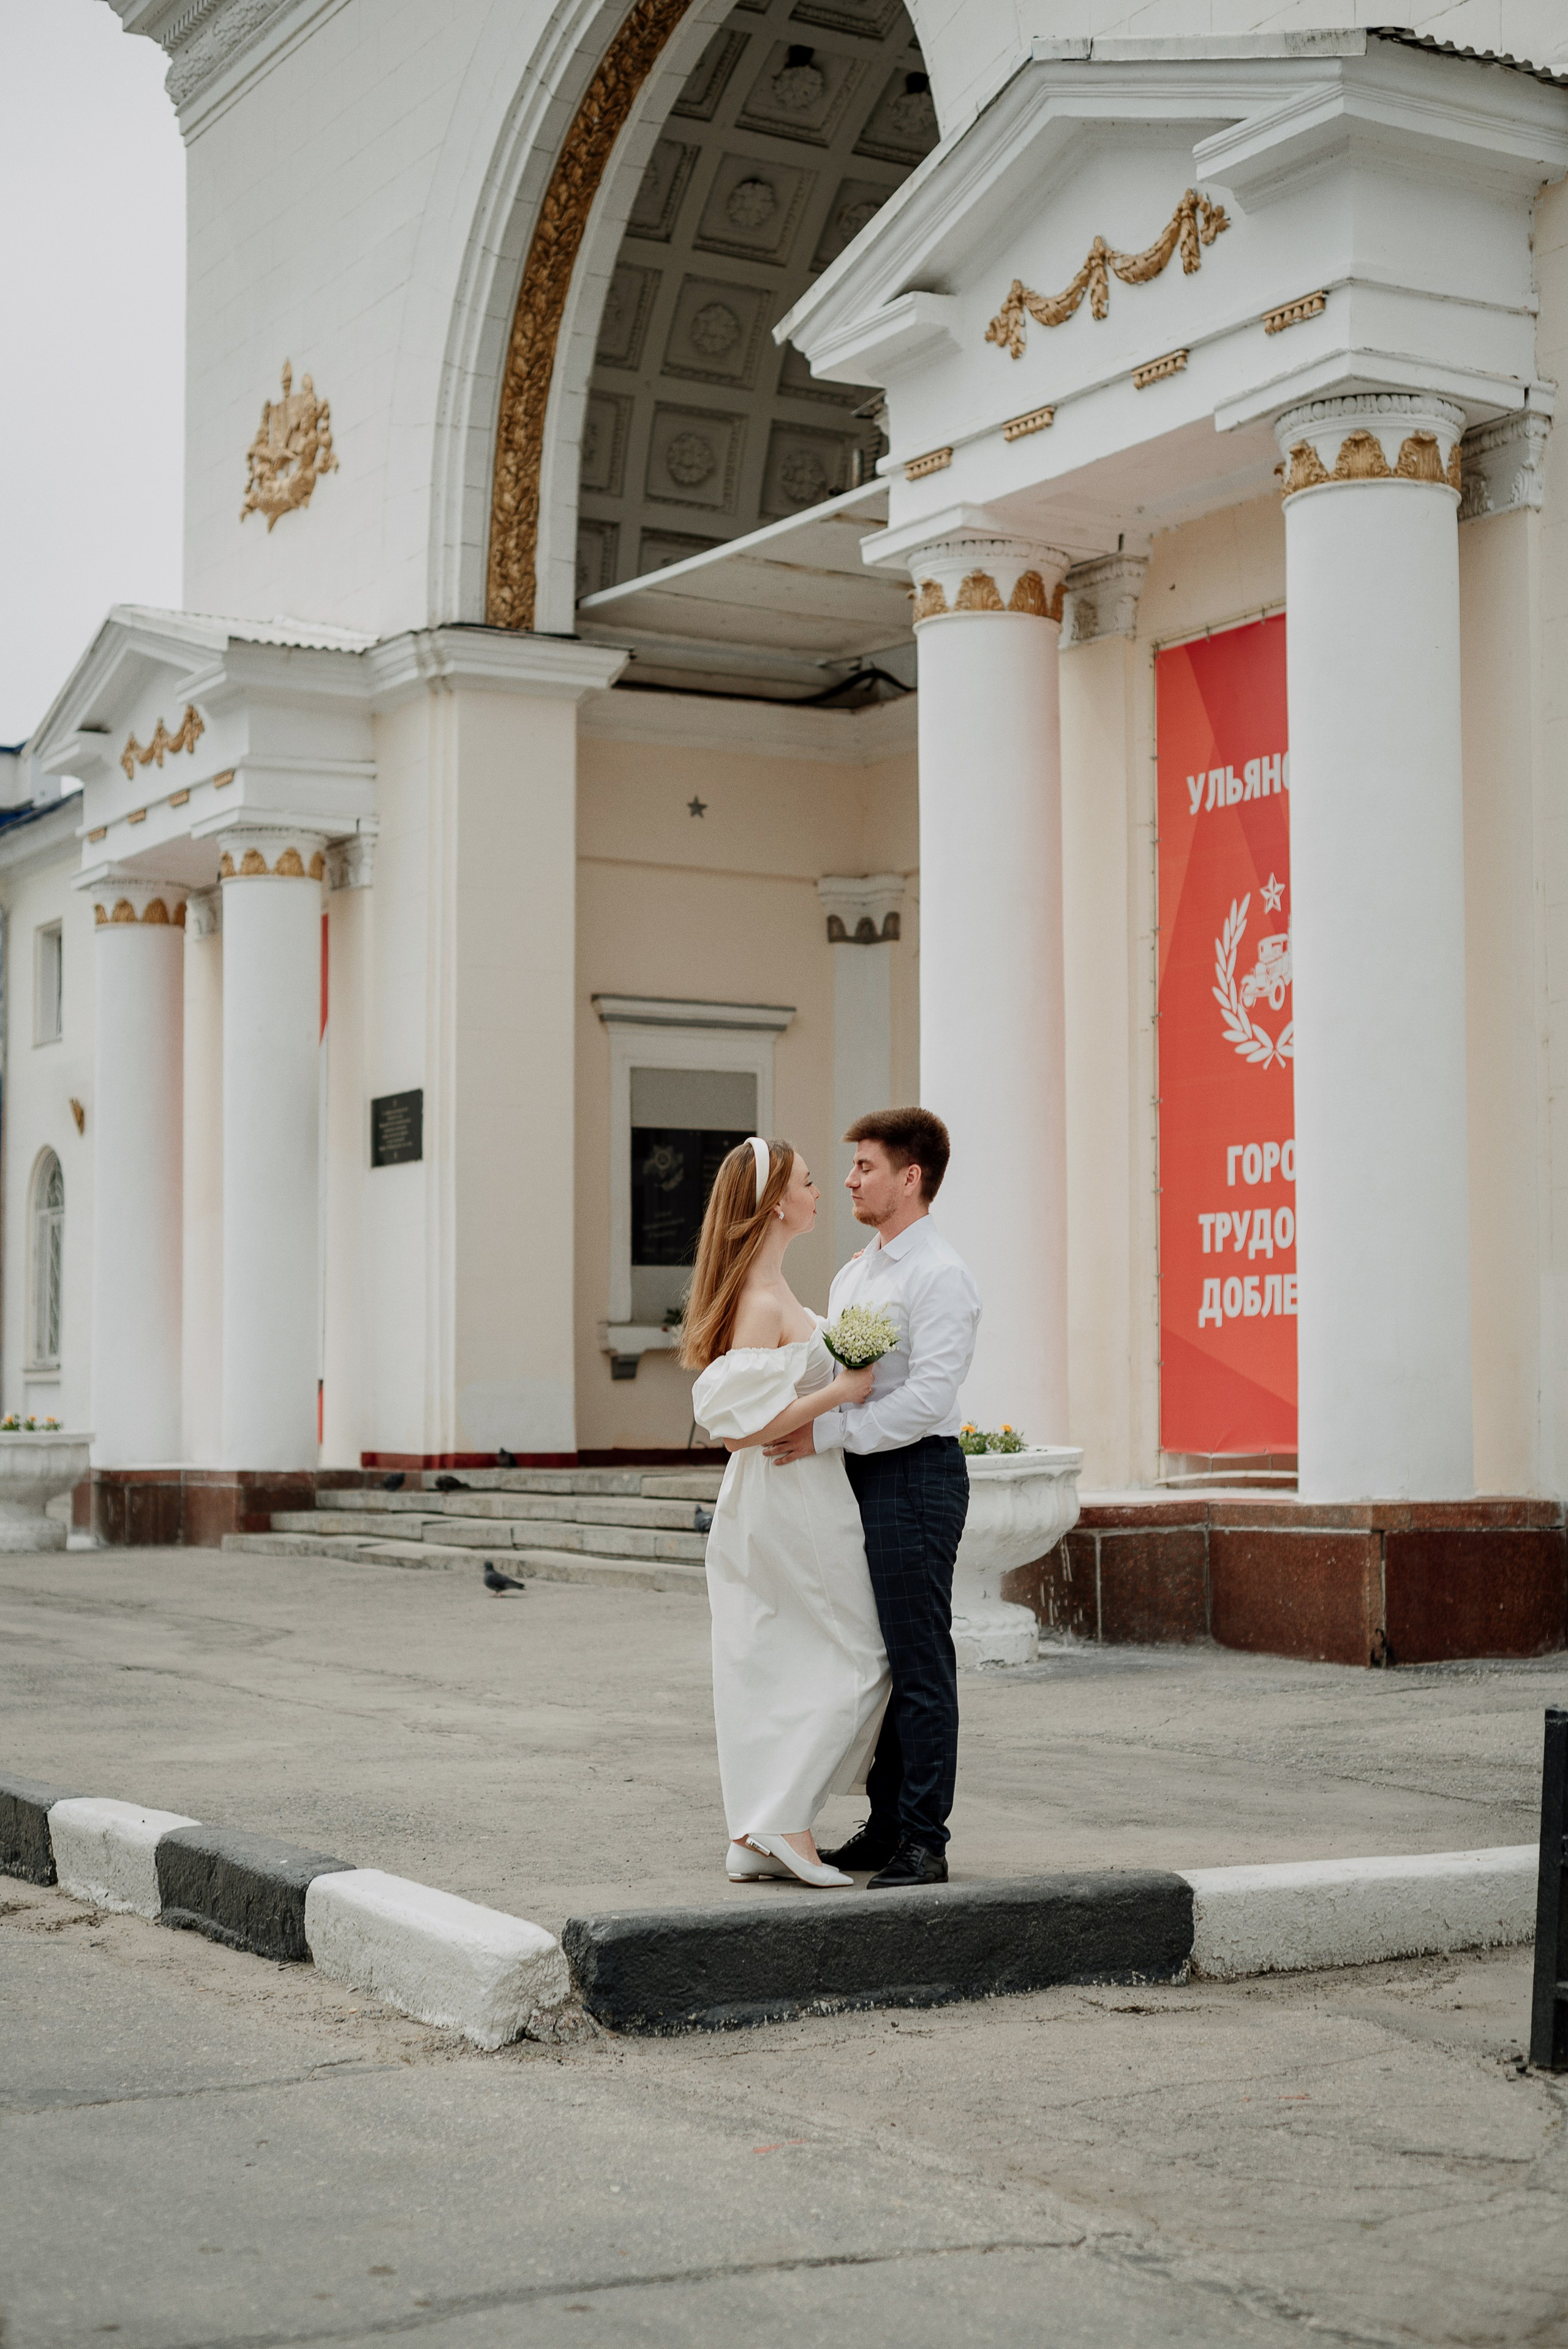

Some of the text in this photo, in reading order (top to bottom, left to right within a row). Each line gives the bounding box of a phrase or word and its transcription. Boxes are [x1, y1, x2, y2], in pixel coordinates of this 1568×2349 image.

[1227, 1139, 1295, 1187] ГОРО
[1198, 1206, 1295, 1260] ТРУДО
[1198, 1273, 1297, 1328] ДОБЛЕ
